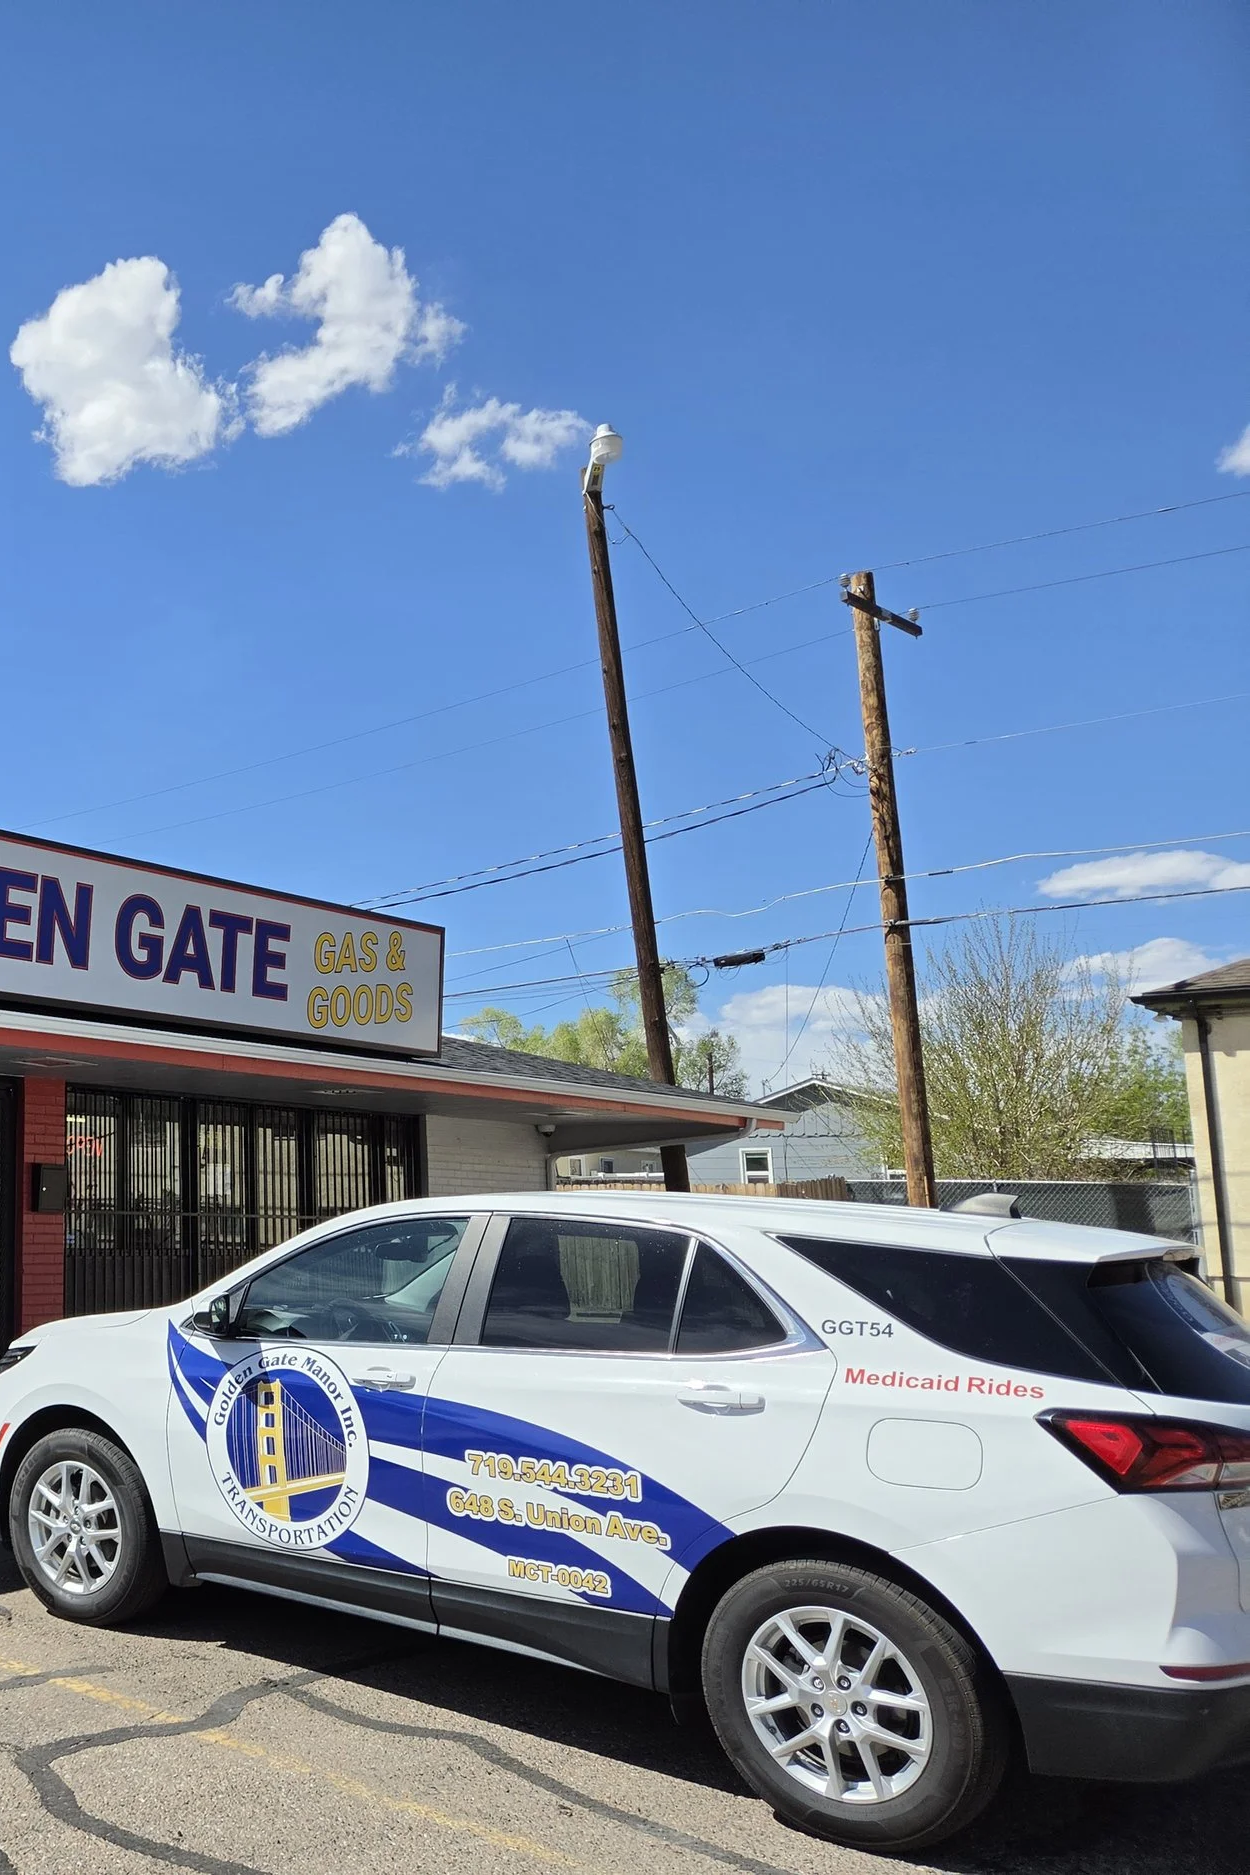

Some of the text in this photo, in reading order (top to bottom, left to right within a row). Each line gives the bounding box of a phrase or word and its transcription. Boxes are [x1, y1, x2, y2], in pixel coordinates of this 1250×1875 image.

[114, 893, 292, 1002] GATE
[313, 930, 406, 975] GAS &
[307, 982, 413, 1029] GOODS
[821, 1319, 894, 1338] GGT54
[214, 1353, 358, 1448] Golden Gate Manor Inc.
[844, 1368, 1044, 1399] Medicaid Rides
[467, 1453, 639, 1499] 719.544.3231
[222, 1471, 359, 1545] TRANSPORTATION
[450, 1490, 668, 1546] 648 S. Union Ave.
[508, 1559, 609, 1594] MCT-0042
[784, 1578, 849, 1593] 225/65R17
